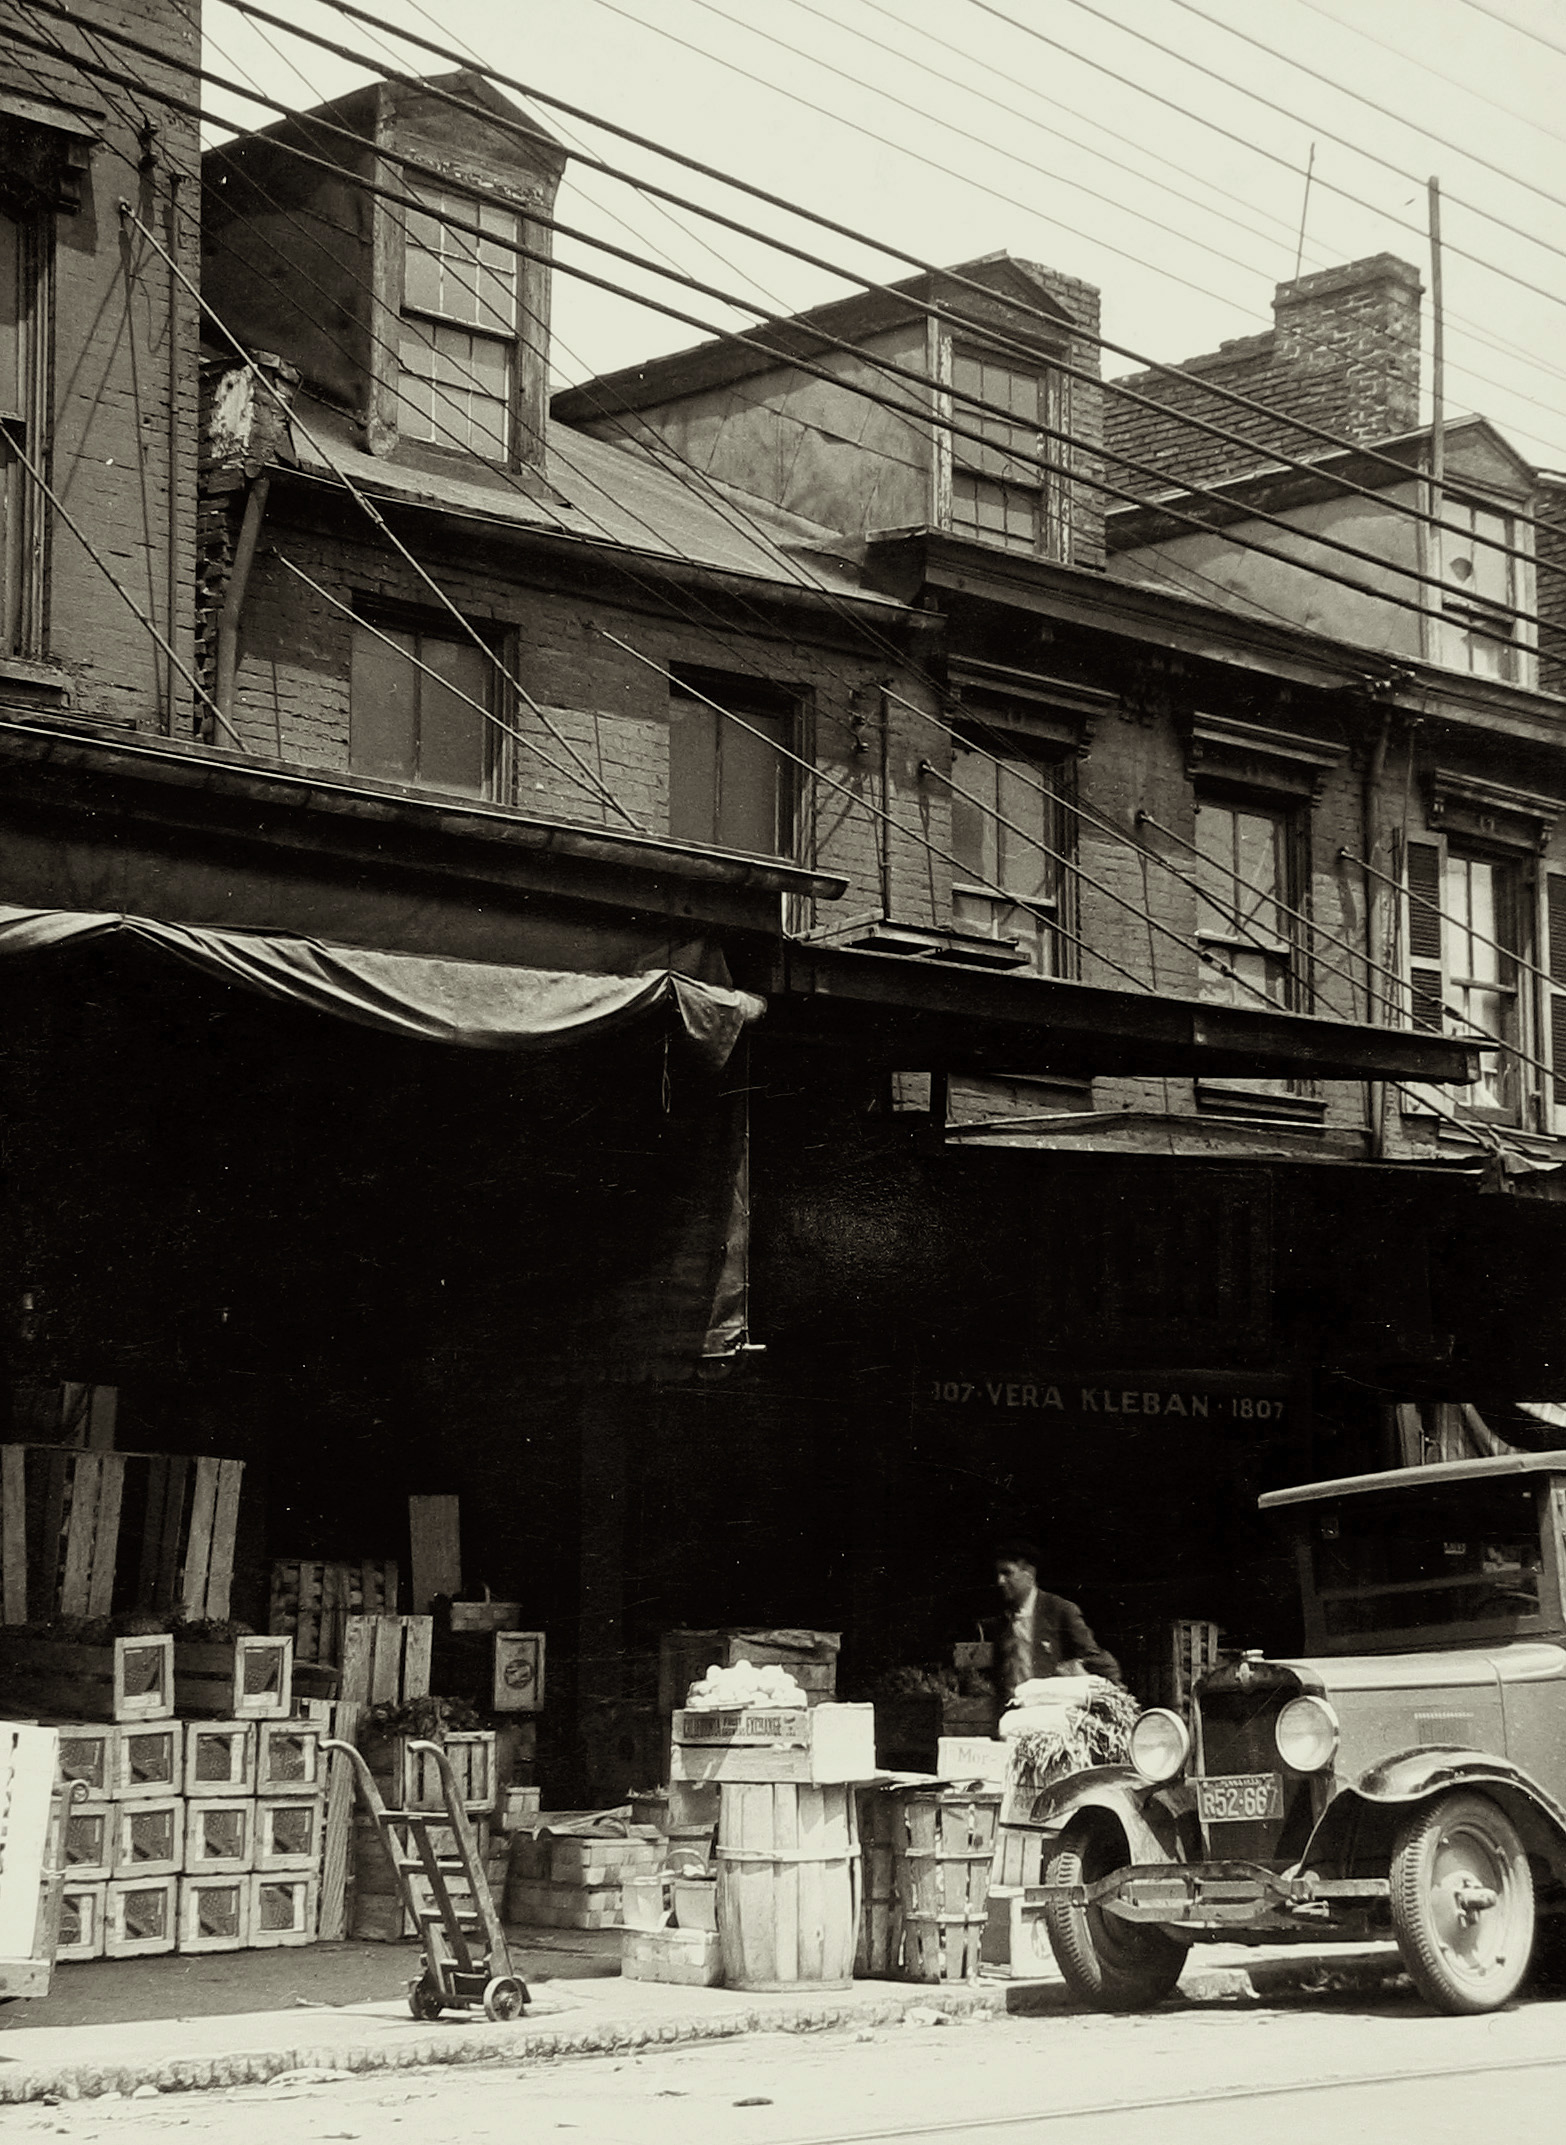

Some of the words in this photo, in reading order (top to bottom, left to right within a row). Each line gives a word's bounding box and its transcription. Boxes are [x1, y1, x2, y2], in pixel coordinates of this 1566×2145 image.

[986, 1381, 1064, 1410] VERA
[1081, 1387, 1209, 1418] KLEBAN
[1231, 1398, 1284, 1419] 1807
